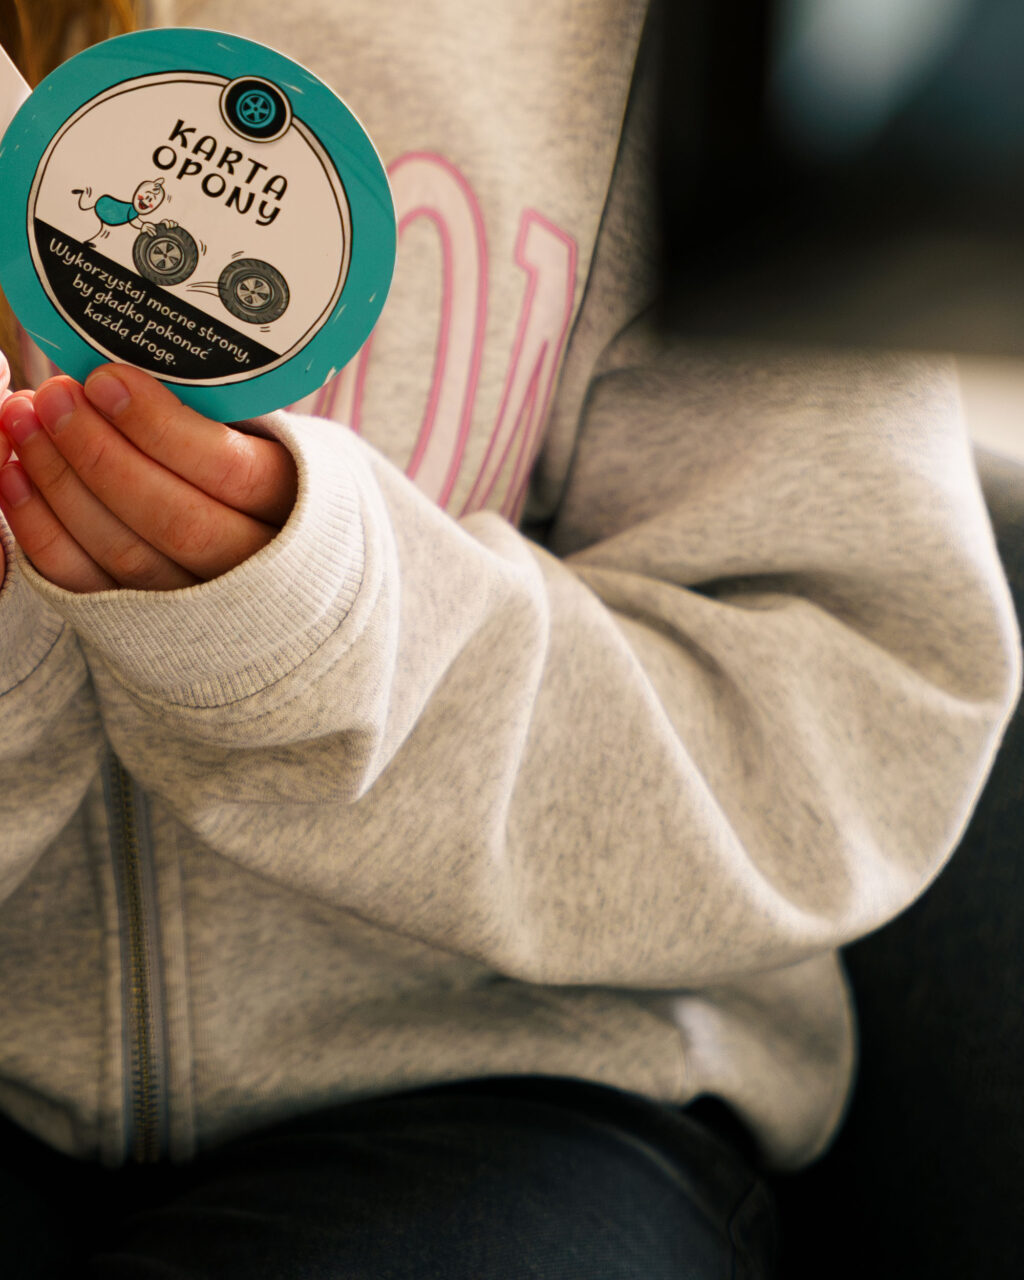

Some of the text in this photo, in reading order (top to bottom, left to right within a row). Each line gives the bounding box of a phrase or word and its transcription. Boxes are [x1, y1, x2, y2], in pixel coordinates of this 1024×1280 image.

[152, 145, 281, 227] OPONY
[168, 119, 288, 201] KARTA
[49, 237, 252, 364] Wykorzystaj mocne strony,
[72, 273, 213, 360] by gładko pokonać
[83, 302, 177, 366] każdą drogę.
